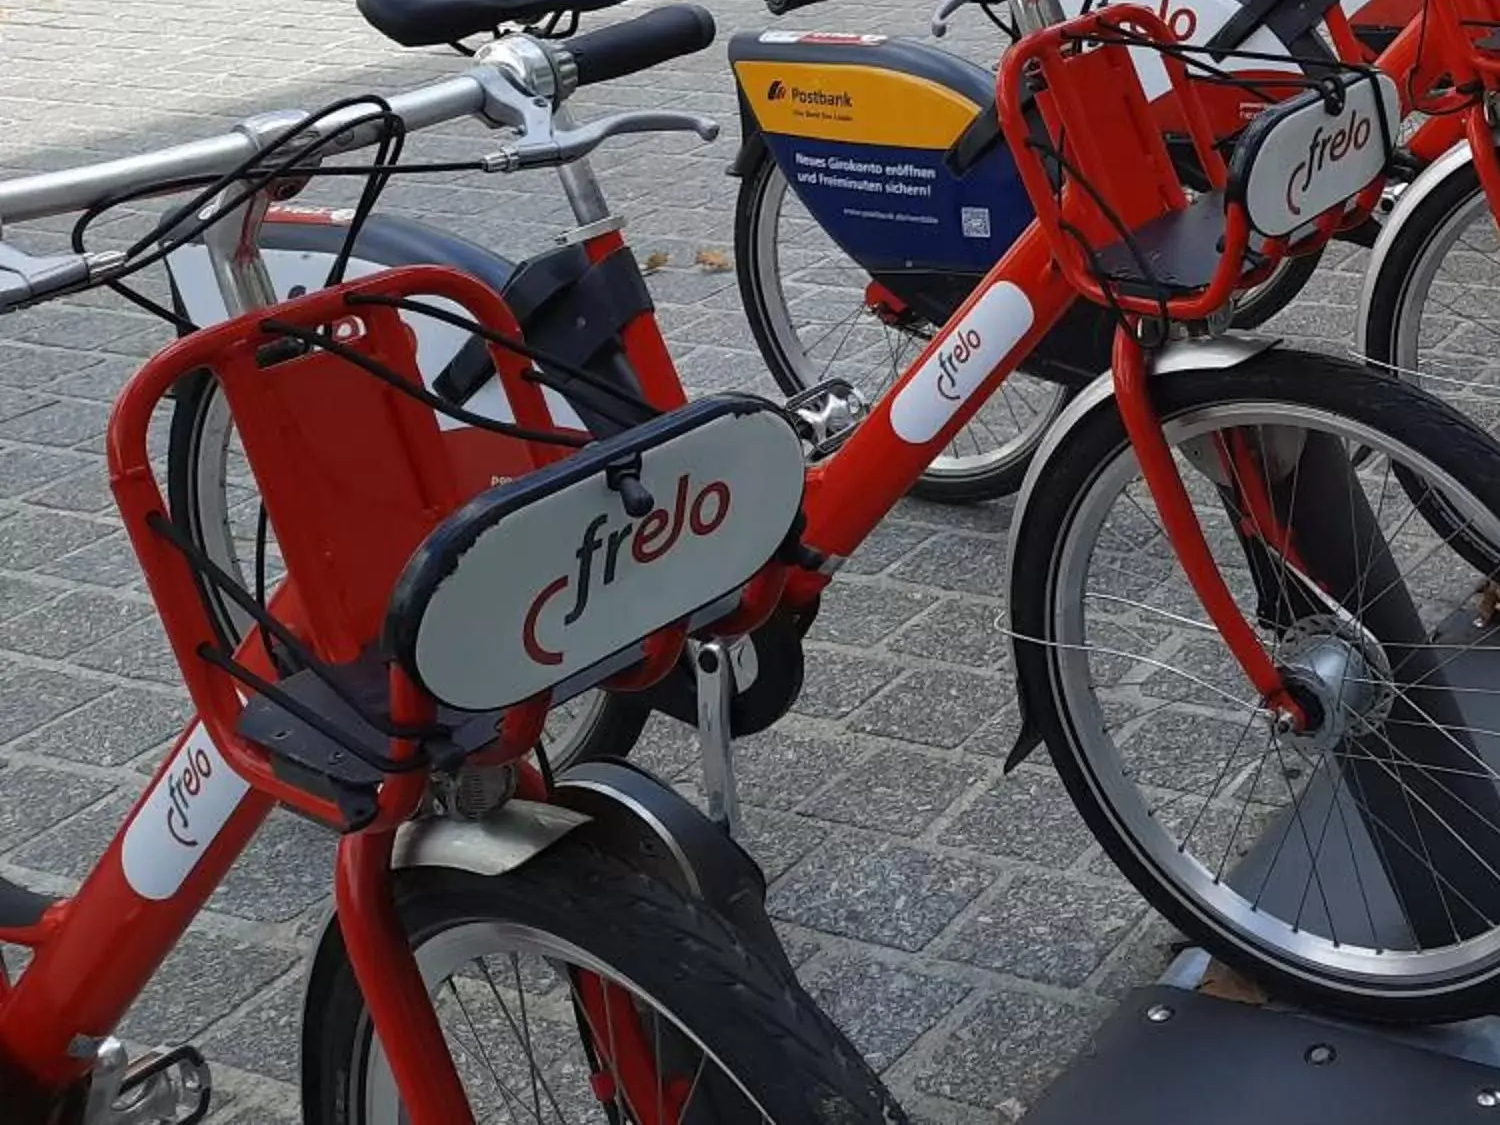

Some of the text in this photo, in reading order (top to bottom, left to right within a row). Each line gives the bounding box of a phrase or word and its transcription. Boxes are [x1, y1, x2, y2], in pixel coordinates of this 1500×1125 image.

[791, 87, 854, 108] Postbank
[795, 152, 937, 179] Neues Girokonto eröffnen
[1301, 109, 1371, 192] frelo
[798, 172, 818, 185] und
[884, 182, 931, 198] sichern!
[938, 329, 981, 388] frelo
[563, 474, 732, 626] frelo
[168, 745, 212, 829] frelo
